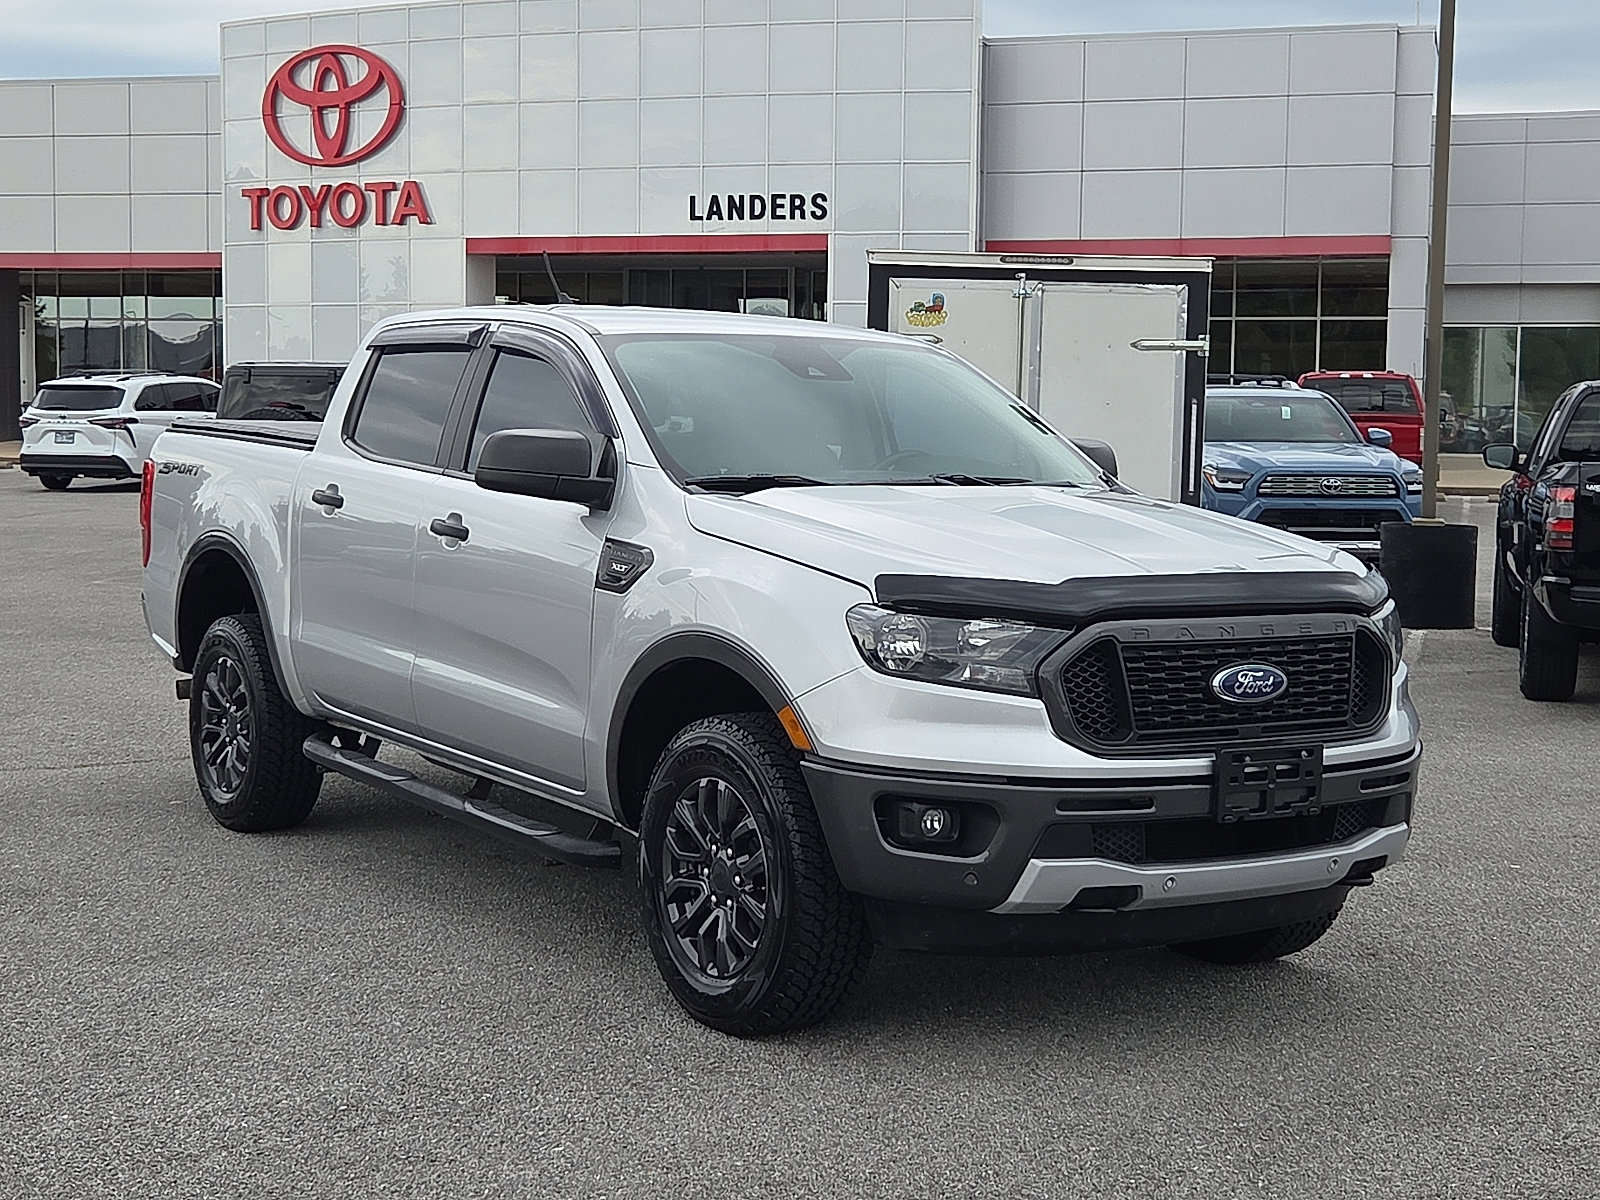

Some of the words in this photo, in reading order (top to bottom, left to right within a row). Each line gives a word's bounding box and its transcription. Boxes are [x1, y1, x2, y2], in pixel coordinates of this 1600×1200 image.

[241, 181, 432, 230] TOYOTA
[689, 193, 828, 221] LANDERS
[158, 462, 200, 476] SPORT
[610, 562, 629, 572] XLT
[1130, 620, 1349, 640] RANGER
[1233, 670, 1274, 695] Ford
